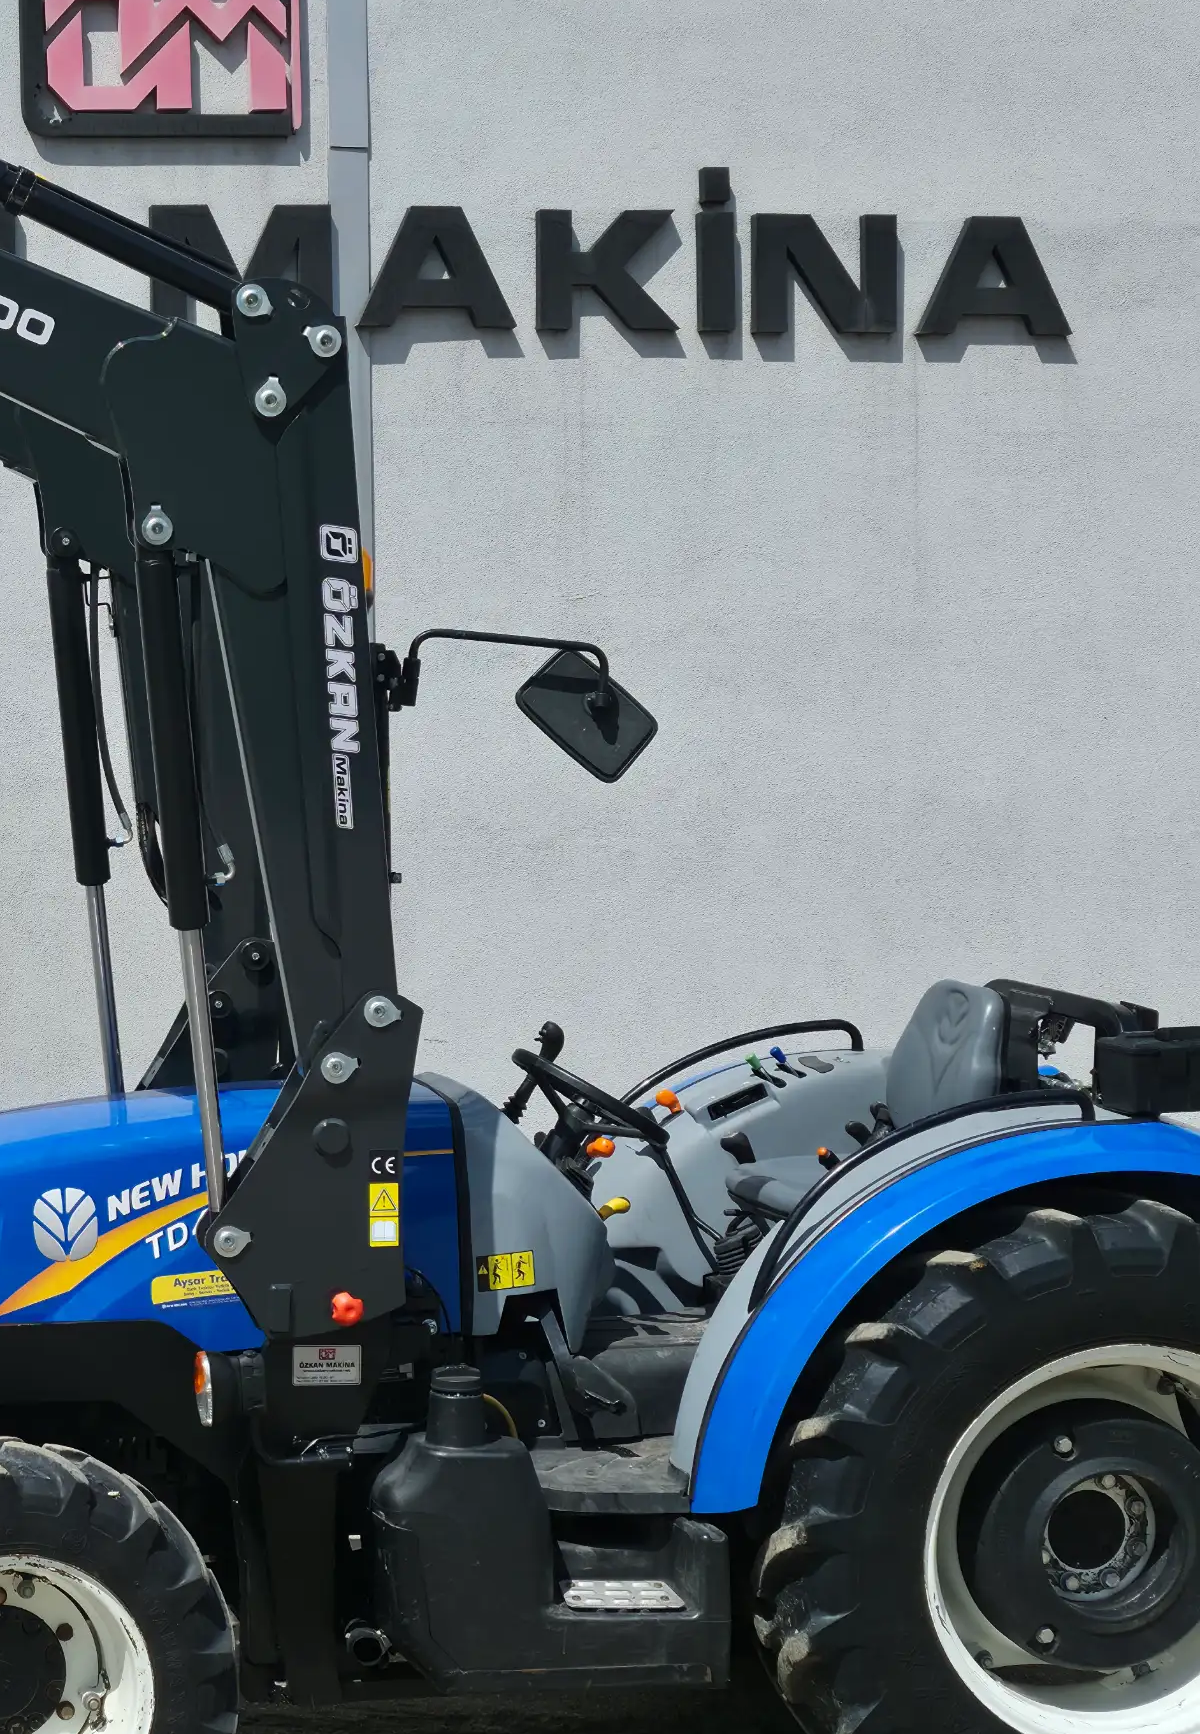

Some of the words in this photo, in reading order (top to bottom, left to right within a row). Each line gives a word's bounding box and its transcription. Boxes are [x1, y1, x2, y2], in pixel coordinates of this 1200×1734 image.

[149, 166, 1073, 337] MAKİNA
[321, 577, 361, 754] ÖZKAN
[334, 755, 351, 828] Makina
[107, 1168, 183, 1222] NEW
[173, 1276, 206, 1289] Aysar
